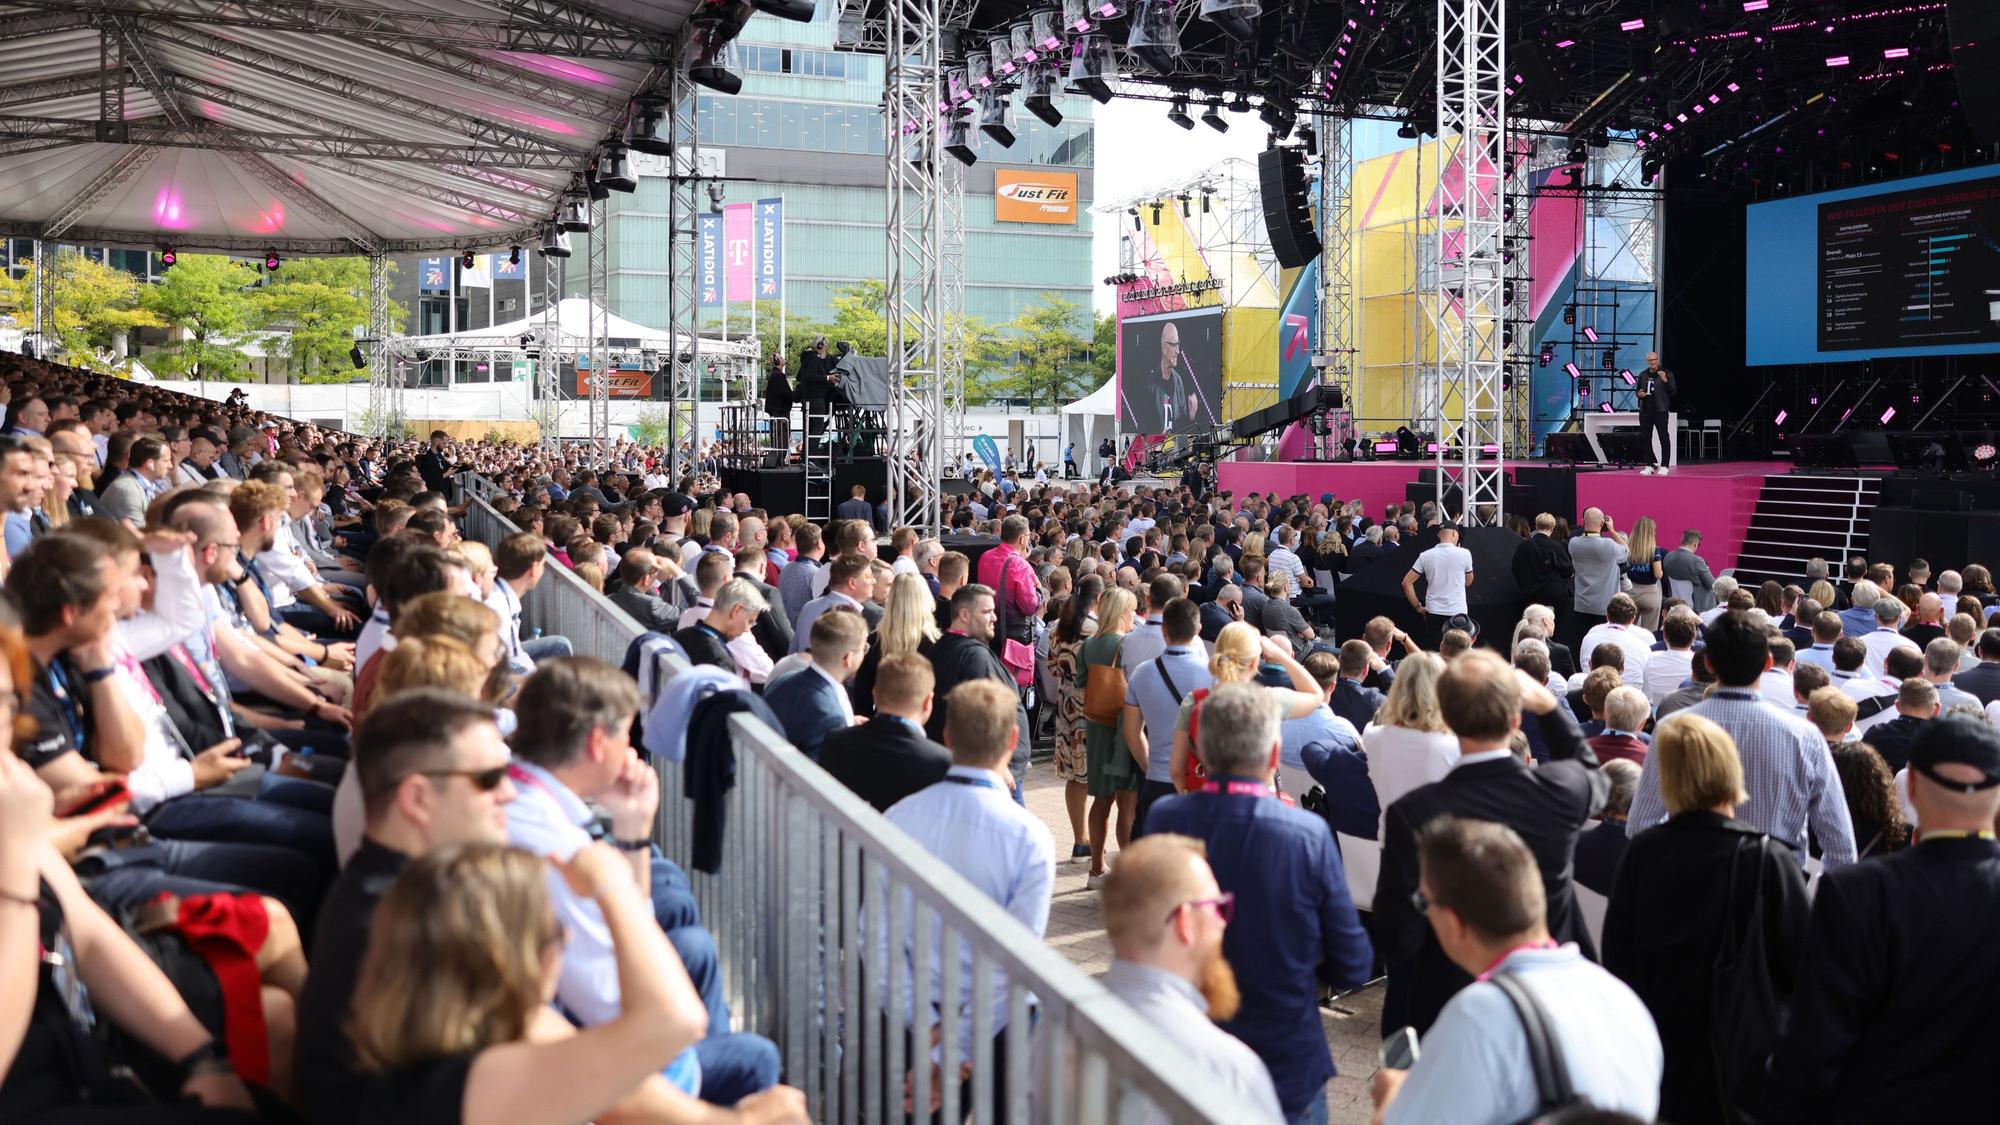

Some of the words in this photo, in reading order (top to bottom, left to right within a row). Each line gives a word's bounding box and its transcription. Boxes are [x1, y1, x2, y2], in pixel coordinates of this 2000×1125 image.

[1007, 187, 1043, 199] Just
[1046, 189, 1068, 200] Fit
[729, 239, 748, 266] T
[621, 378, 640, 386] Fit
